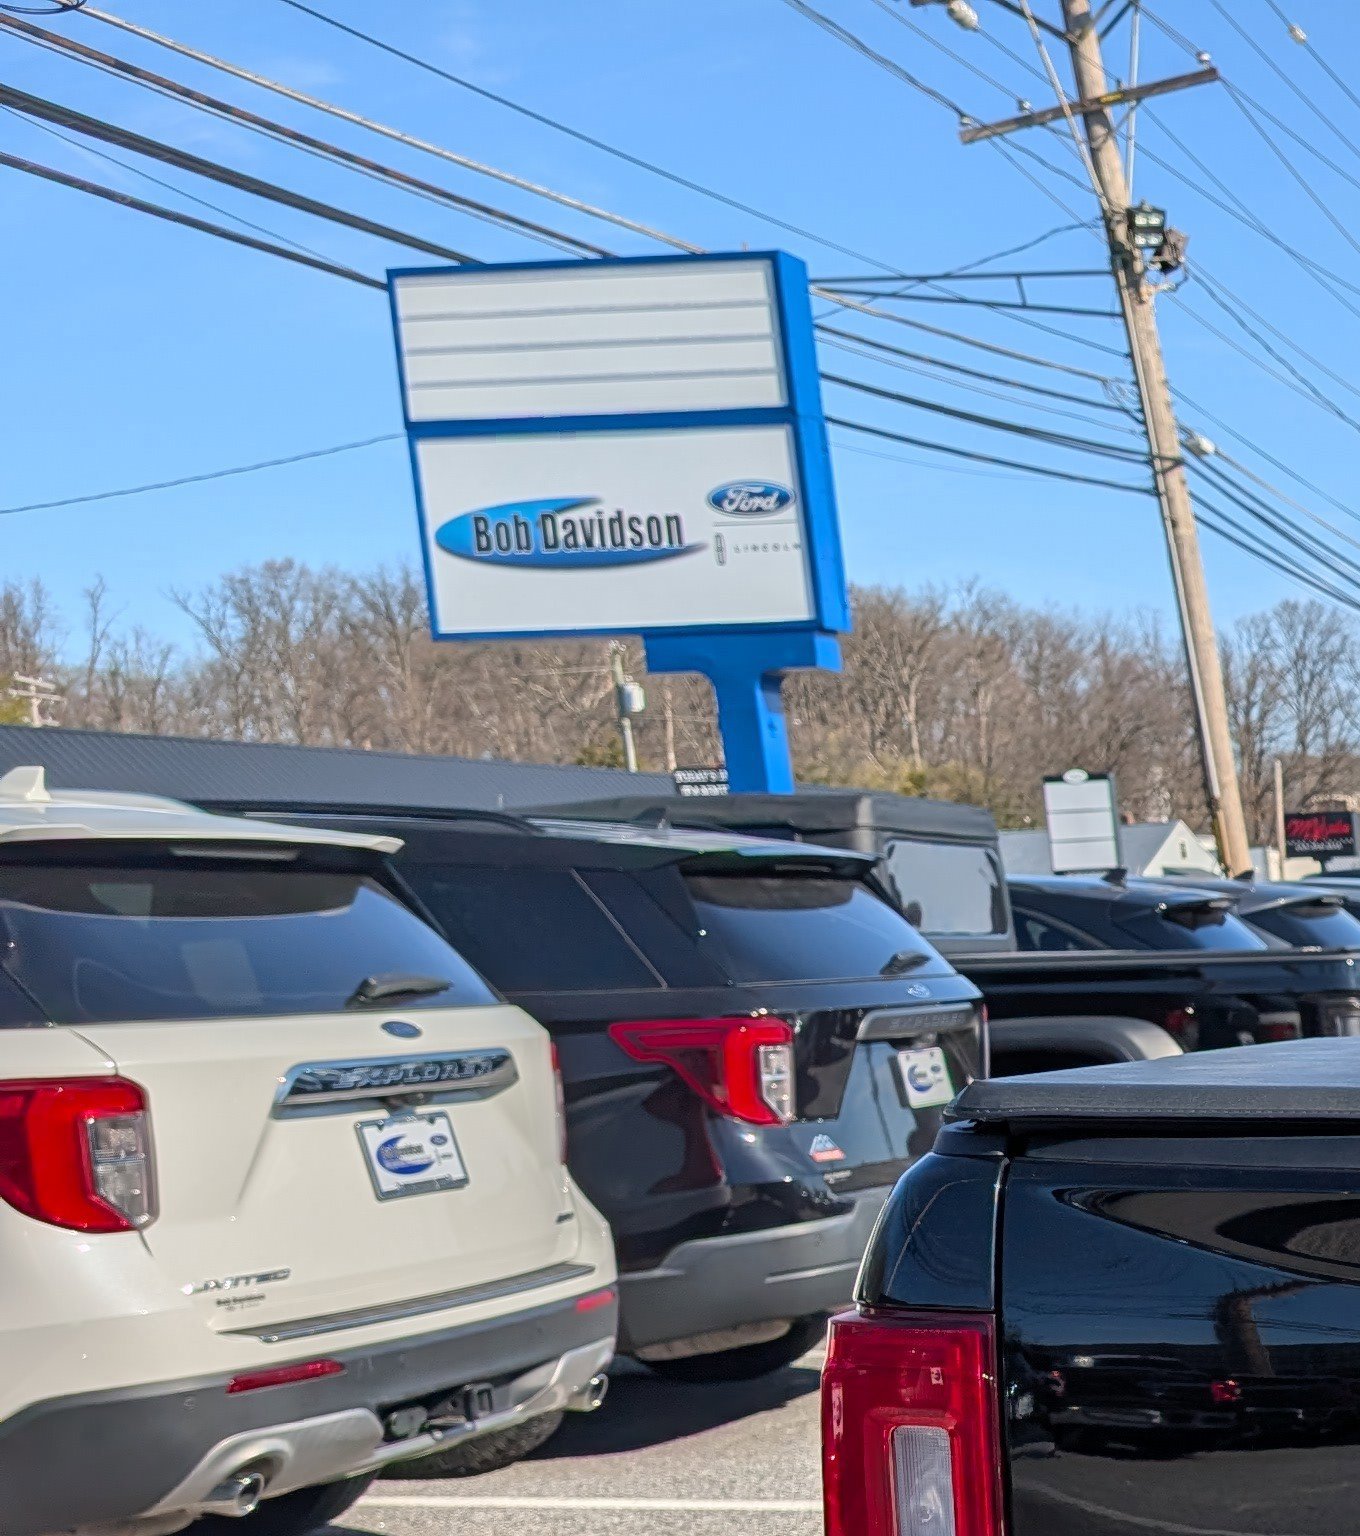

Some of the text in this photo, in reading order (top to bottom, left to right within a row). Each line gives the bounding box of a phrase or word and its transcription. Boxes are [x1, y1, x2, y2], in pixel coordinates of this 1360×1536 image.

[721, 486, 780, 512] Ford
[473, 512, 685, 554] Bob Davidson
